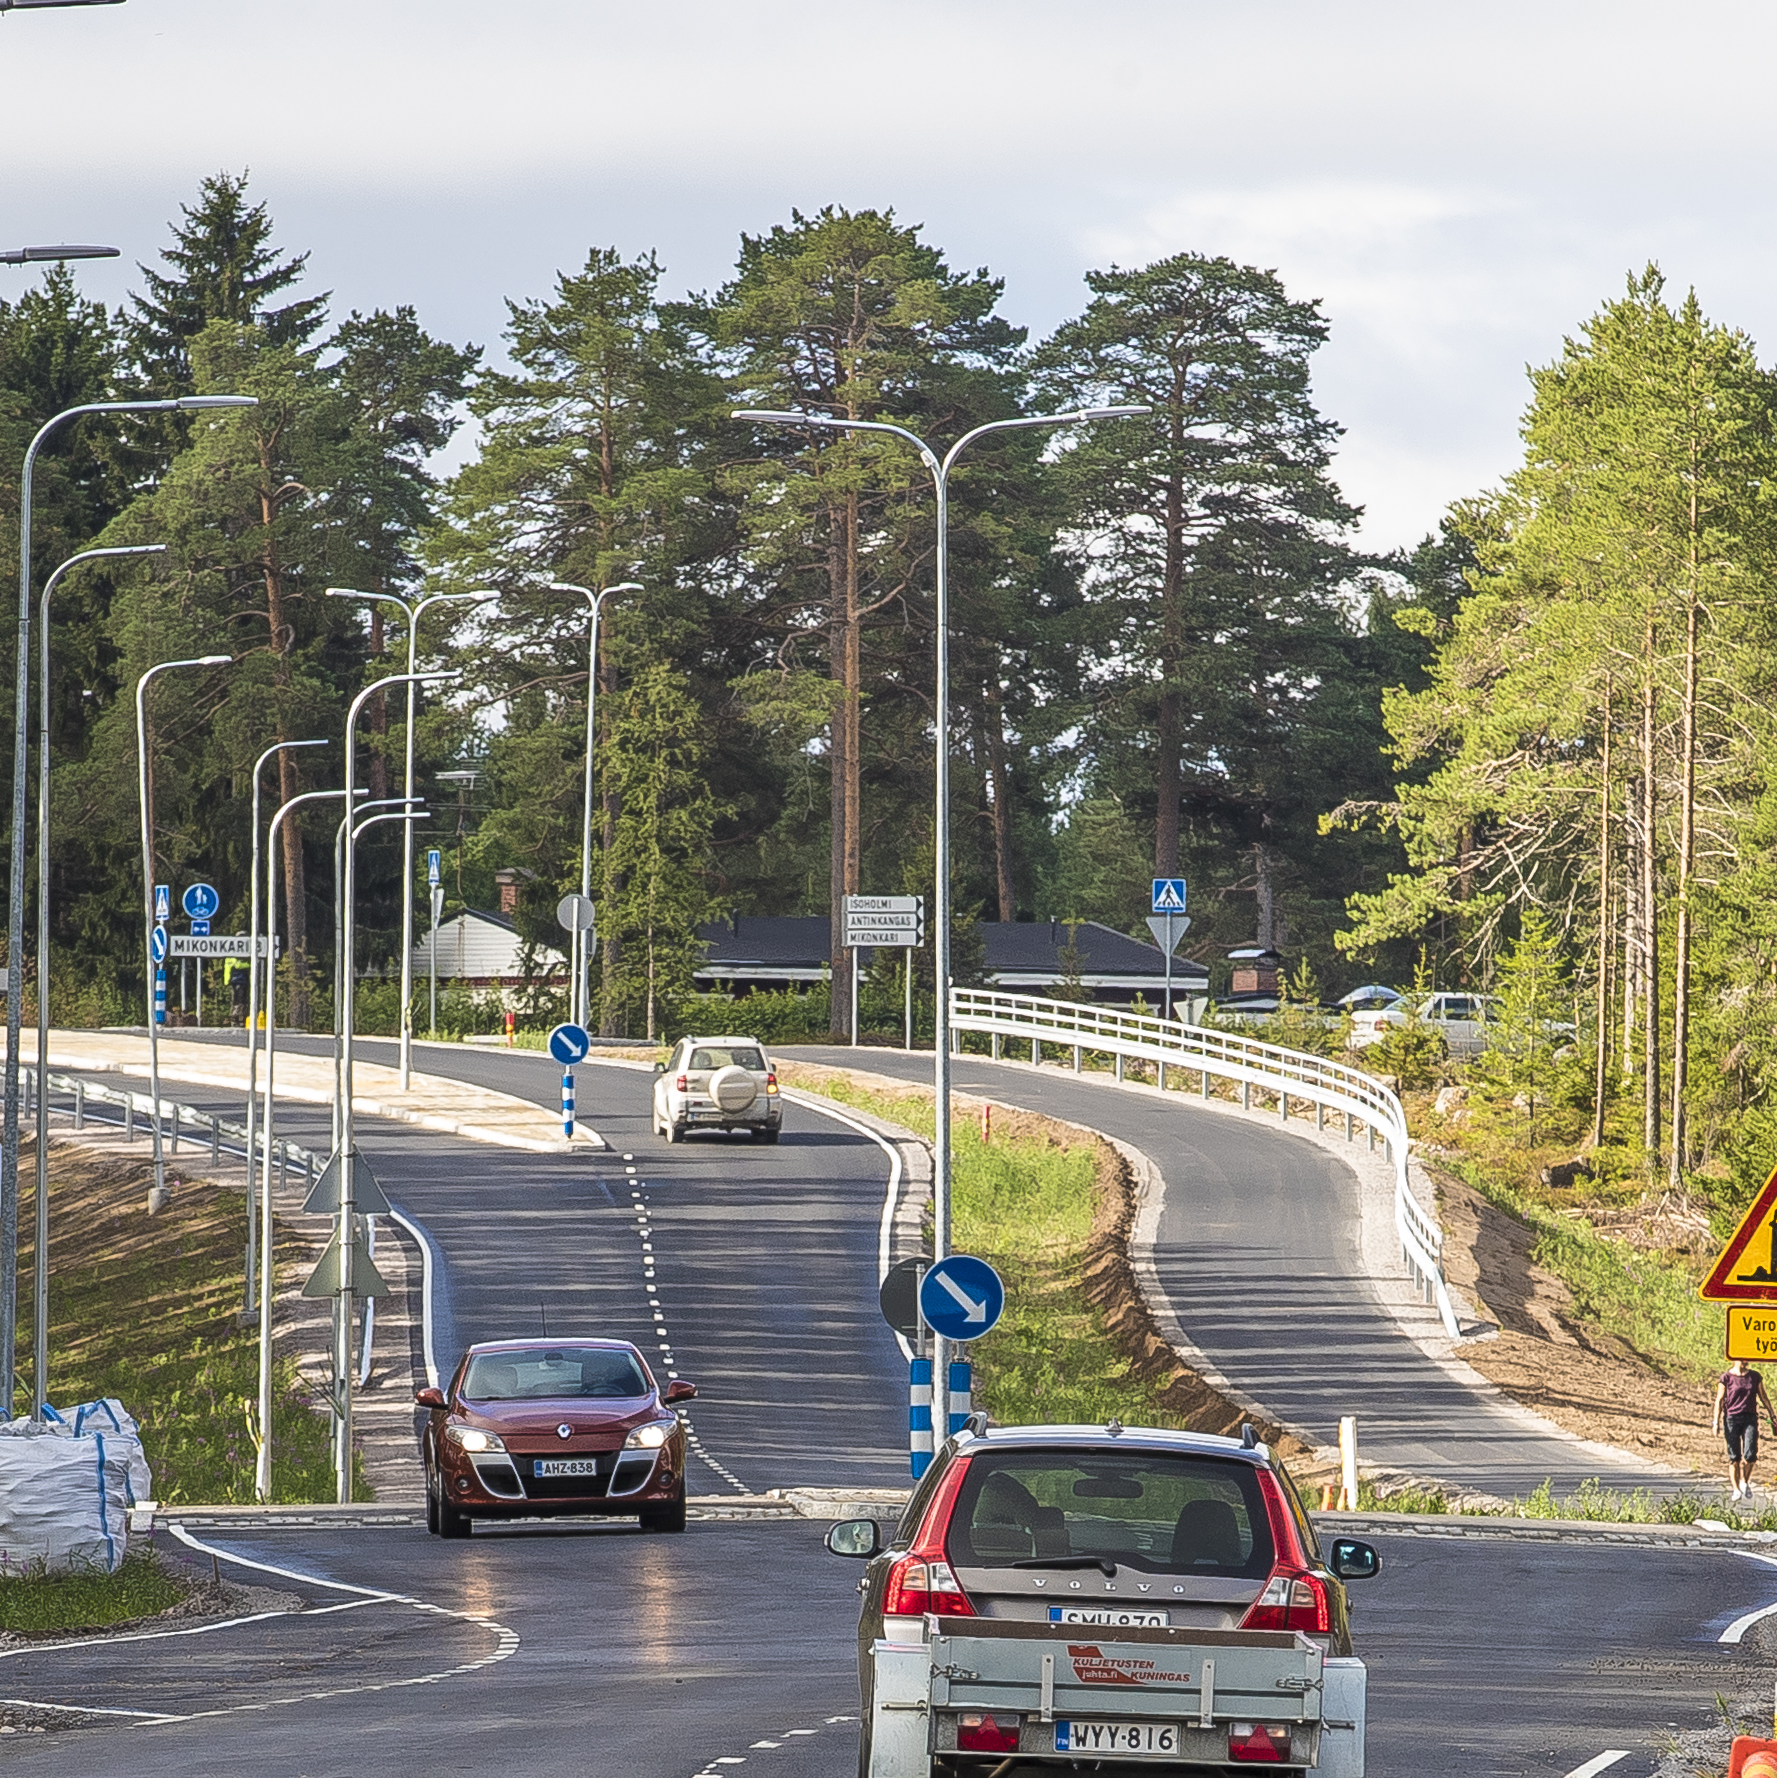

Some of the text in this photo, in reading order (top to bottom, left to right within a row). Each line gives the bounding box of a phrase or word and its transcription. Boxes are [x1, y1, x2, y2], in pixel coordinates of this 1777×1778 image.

[850, 899, 892, 909] ISOHOLMI
[850, 916, 911, 926] ANTINKANGAS
[850, 933, 899, 942] MIKONKARI
[174, 940, 249, 953] MIKONKARI
[1742, 1316, 1776, 1332] Varo
[544, 1462, 593, 1474] AHZ-838
[1033, 1578, 1185, 1594] VOLVO
[1073, 1657, 1155, 1669] KULJETUSTEN
[1130, 1671, 1191, 1682] KUNINGAS
[1073, 1724, 1173, 1751] WYY-816
